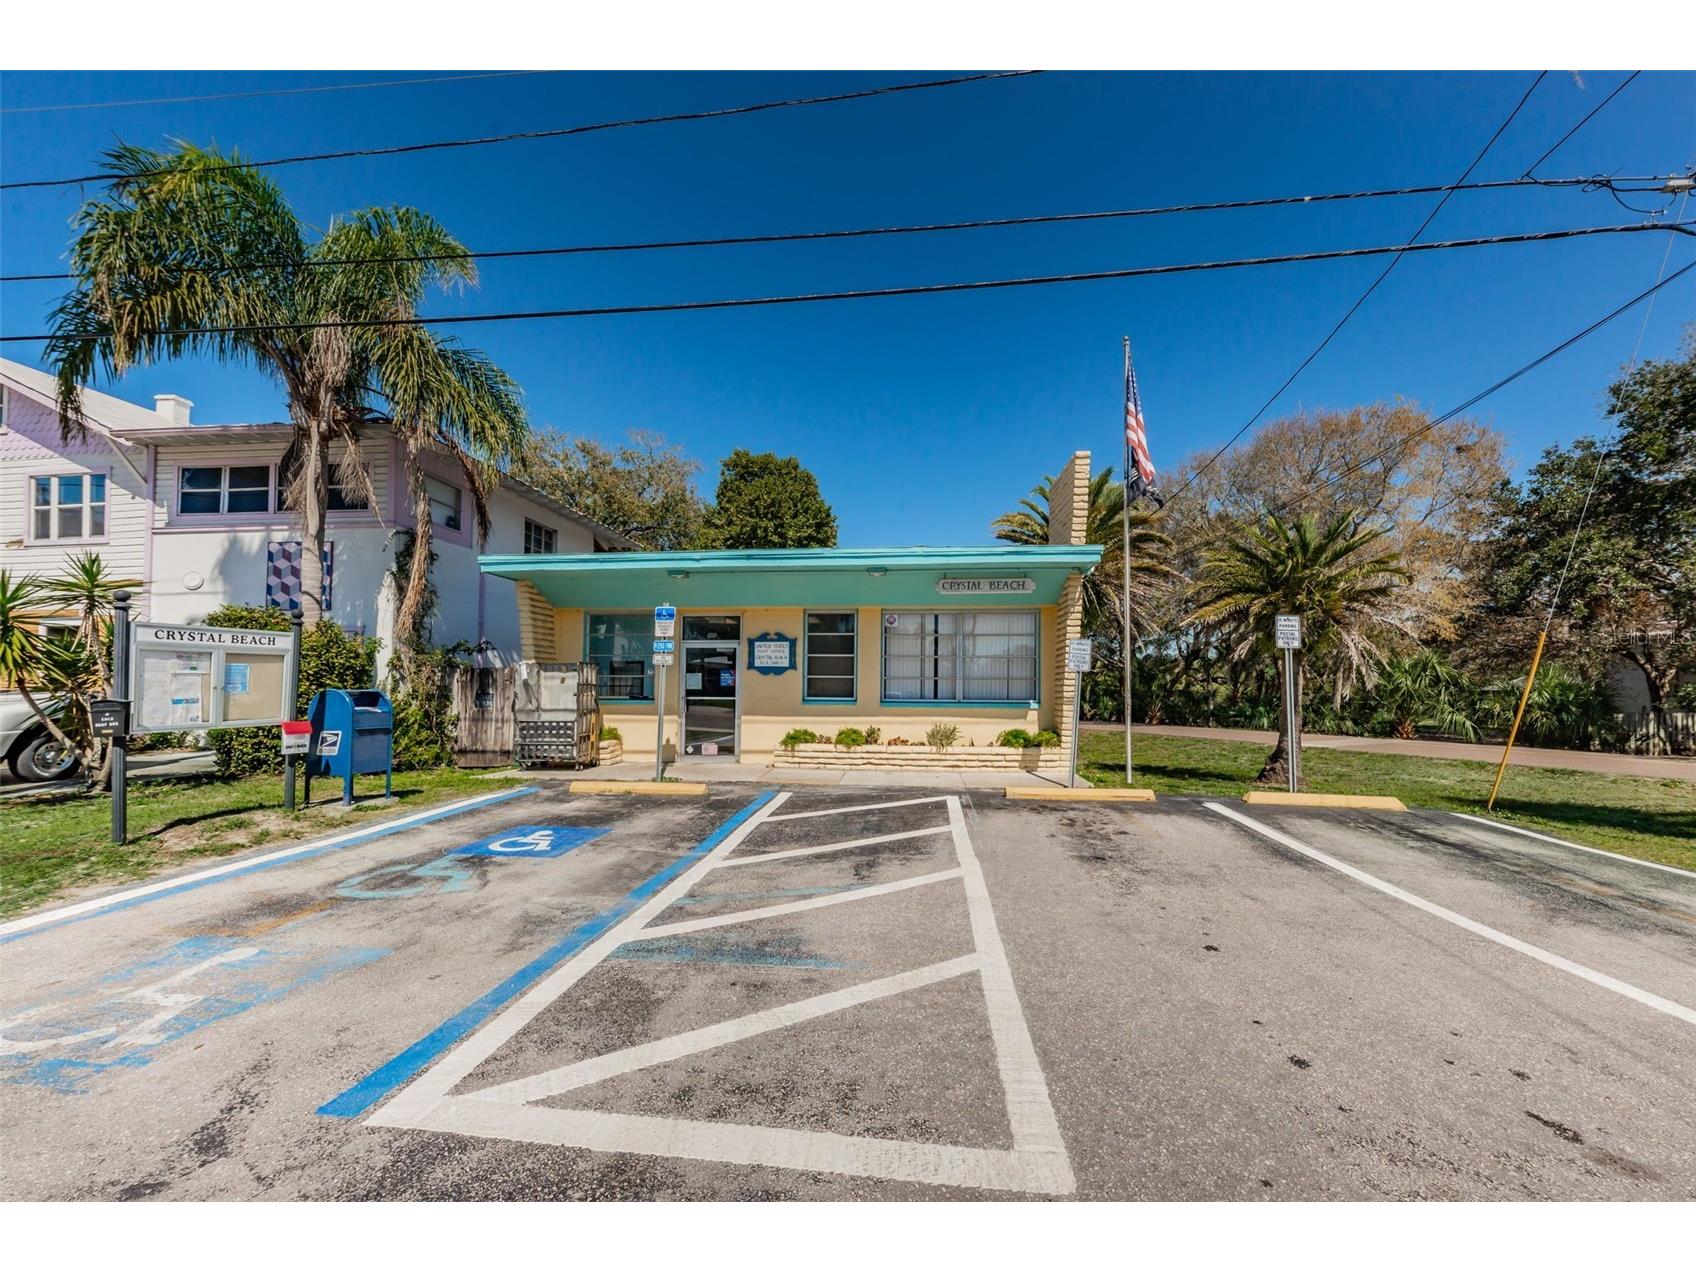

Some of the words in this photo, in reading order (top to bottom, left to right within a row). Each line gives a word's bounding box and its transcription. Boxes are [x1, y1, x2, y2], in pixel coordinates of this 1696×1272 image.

[942, 581, 982, 590] CRYSTAL
[989, 580, 1026, 590] BEACH
[154, 629, 226, 643] CRYSTAL
[231, 634, 276, 646] BEACH
